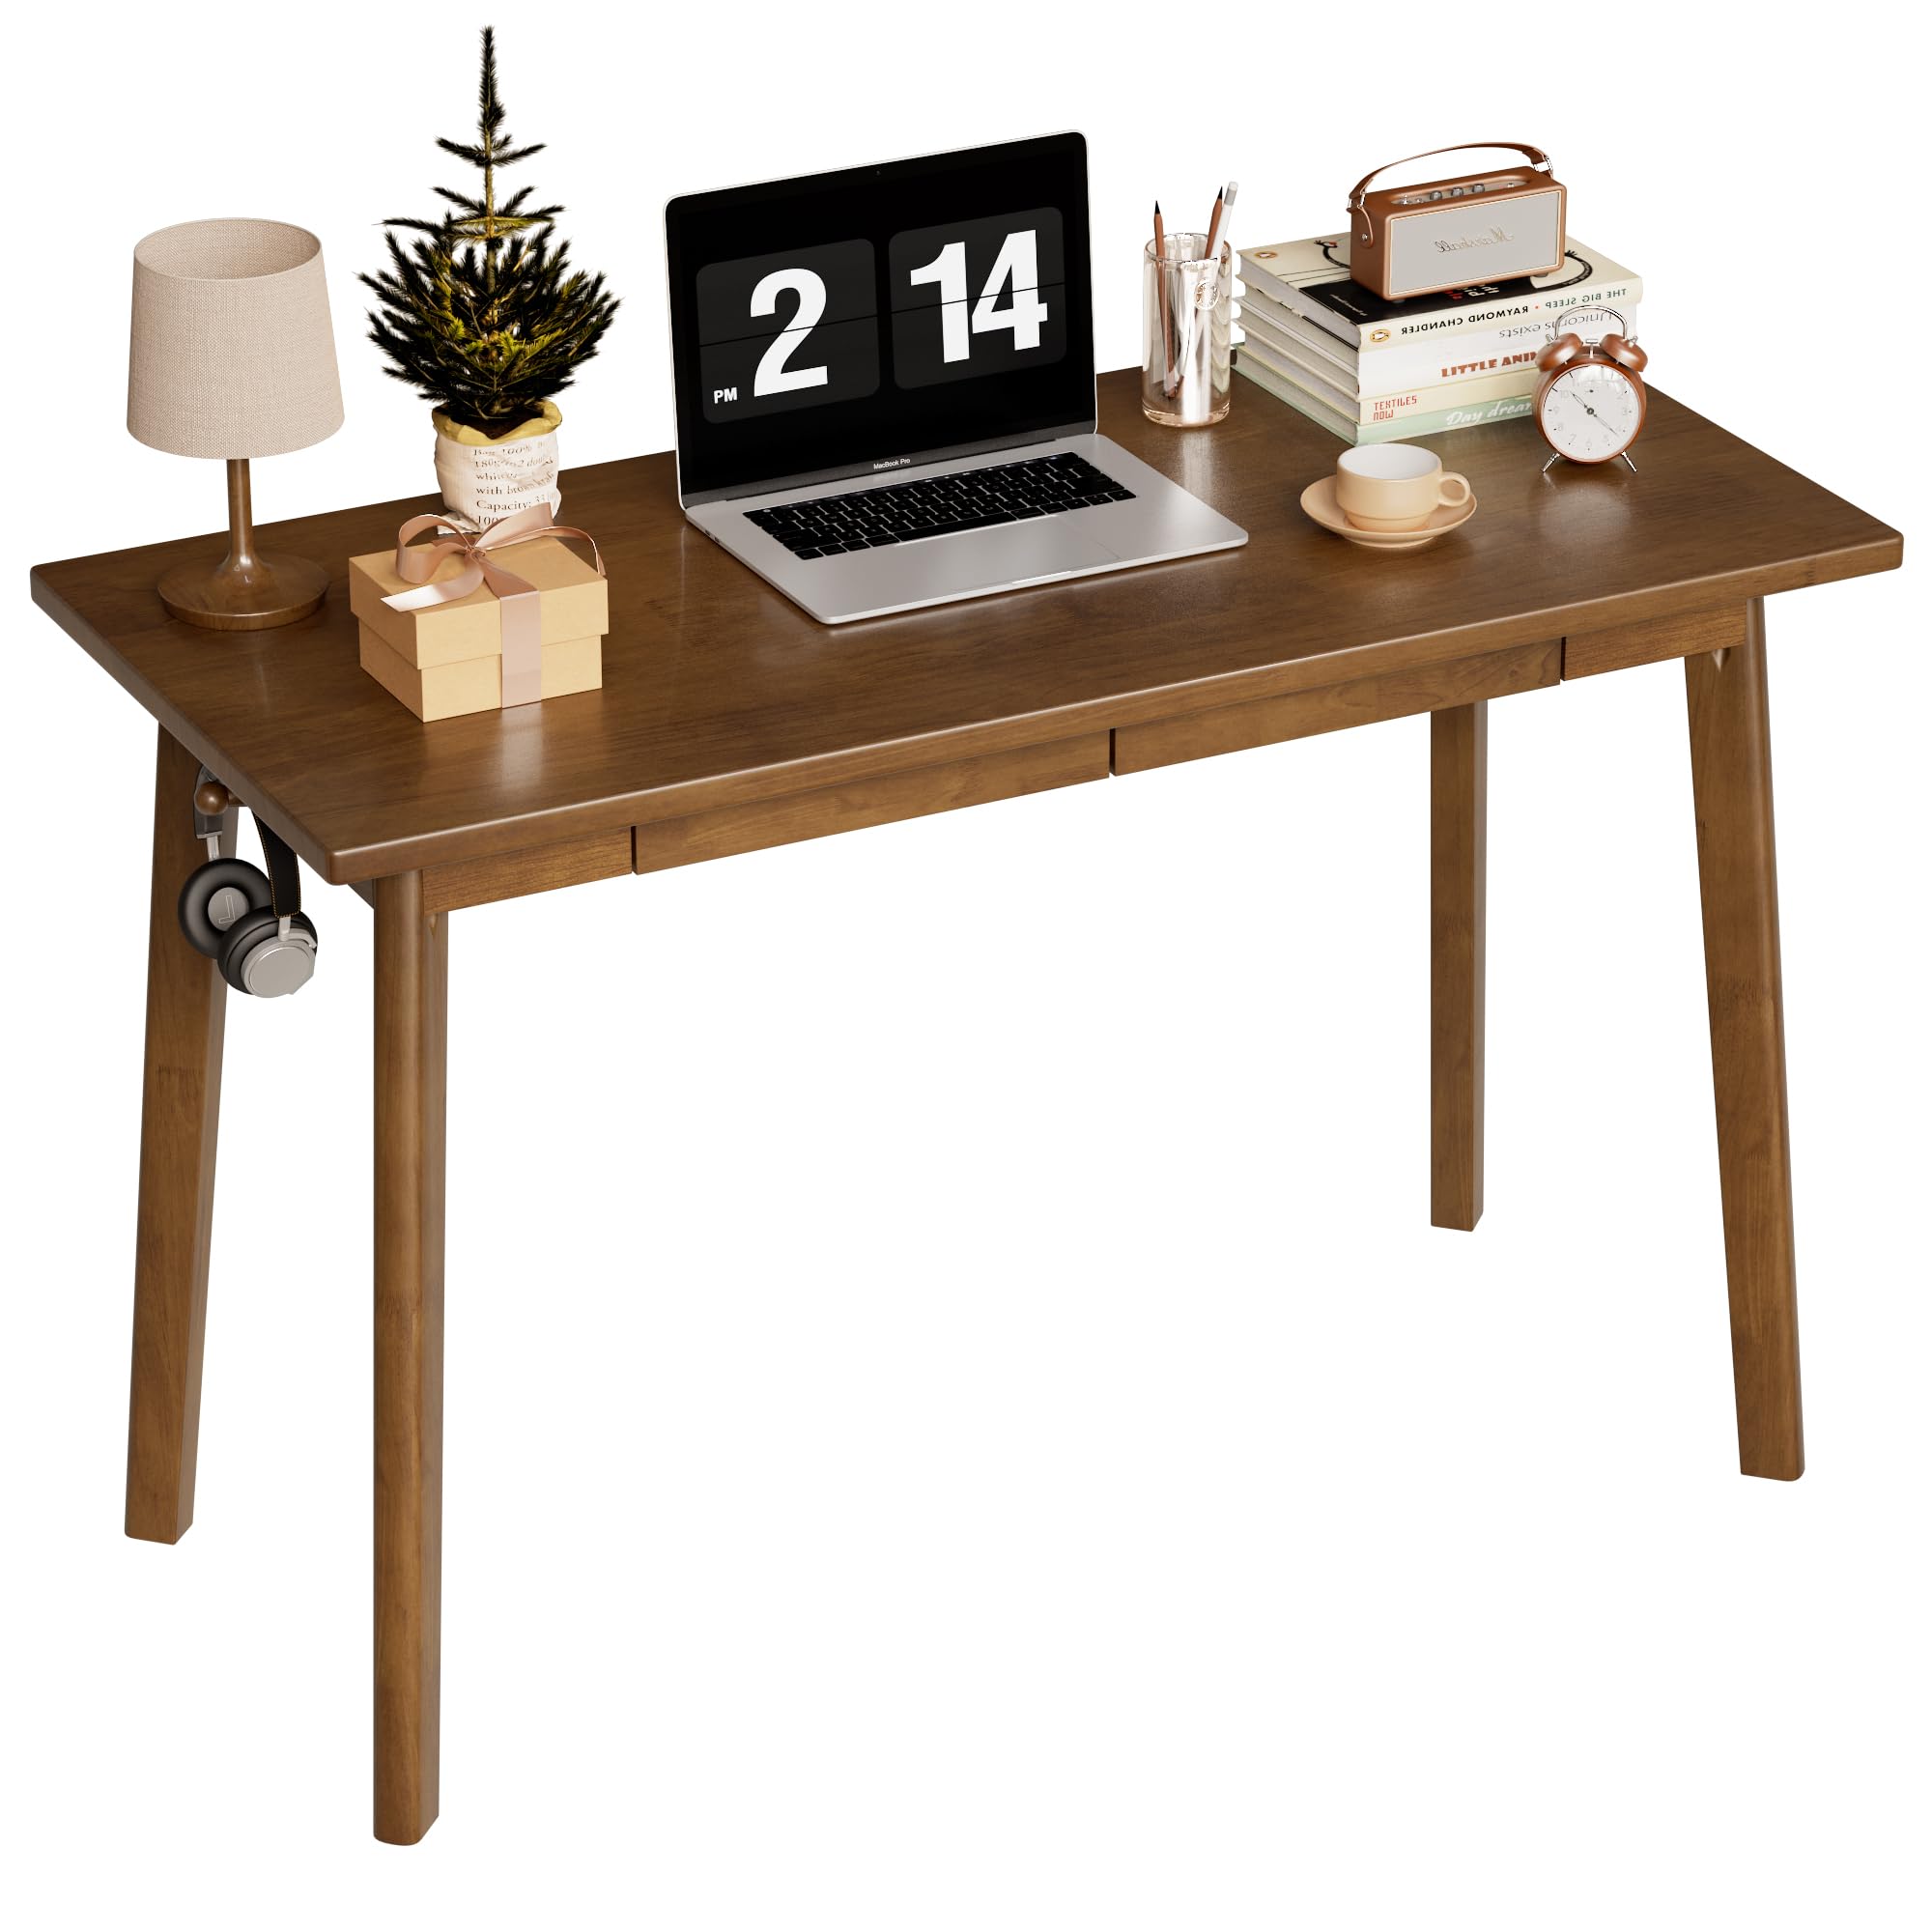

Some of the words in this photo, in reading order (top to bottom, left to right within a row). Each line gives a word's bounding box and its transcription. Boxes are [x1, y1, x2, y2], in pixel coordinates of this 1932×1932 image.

[910, 229, 1049, 363] 14
[750, 268, 829, 398] 2
[1498, 324, 1542, 338] exists
[1441, 358, 1497, 378] LITTLE
[713, 386, 738, 404] PM
[1373, 395, 1418, 412] TEXTILES
[1446, 411, 1483, 426] Day
[873, 459, 899, 470] MacBook
[475, 486, 502, 495] with
[476, 499, 531, 513] Capacity:
